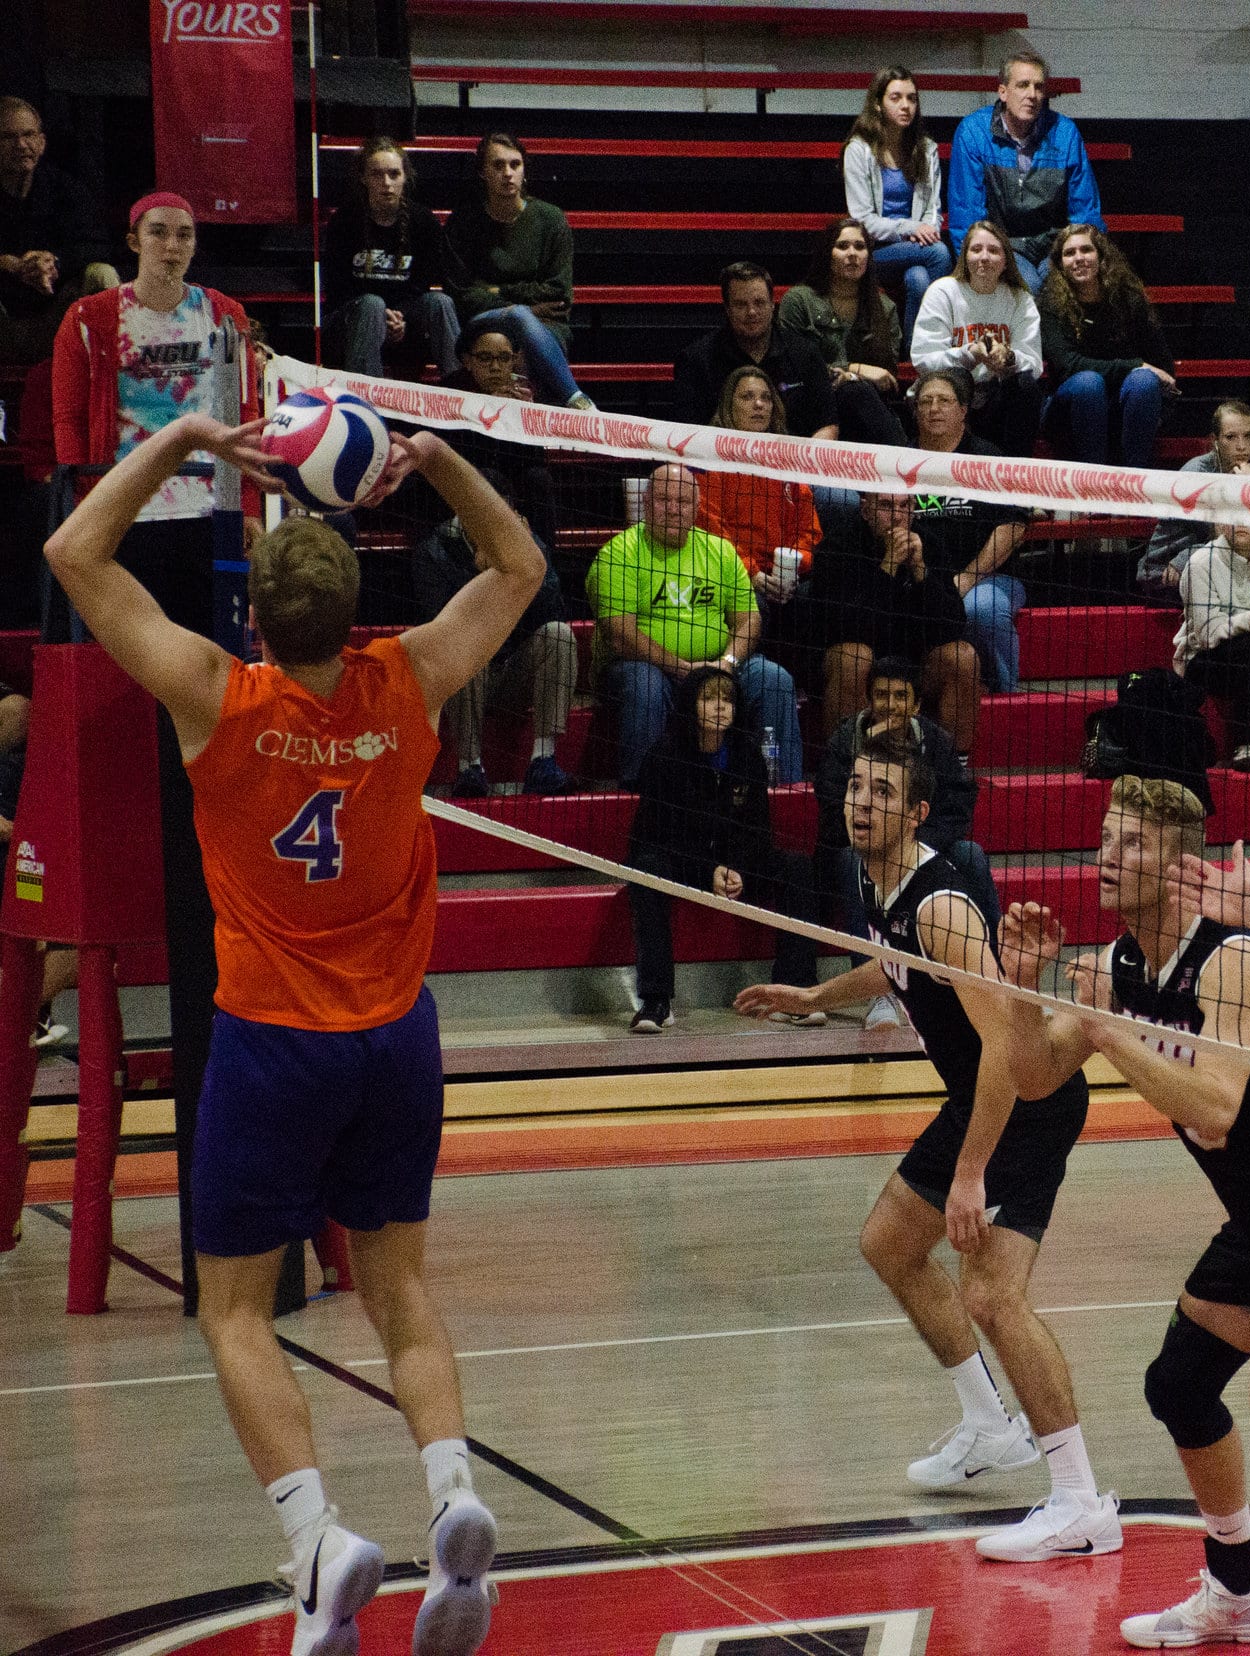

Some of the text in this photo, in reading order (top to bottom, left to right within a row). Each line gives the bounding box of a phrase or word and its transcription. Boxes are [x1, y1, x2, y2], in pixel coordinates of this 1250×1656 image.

[161, 0, 281, 43] YOURS
[139, 341, 202, 362] NGU
[715, 434, 883, 482] NORTH GREENVILLE UNIVERSITY
[951, 459, 1153, 504] NORTH GREENVILLE UNIVERSITY
[269, 788, 345, 883] 4
